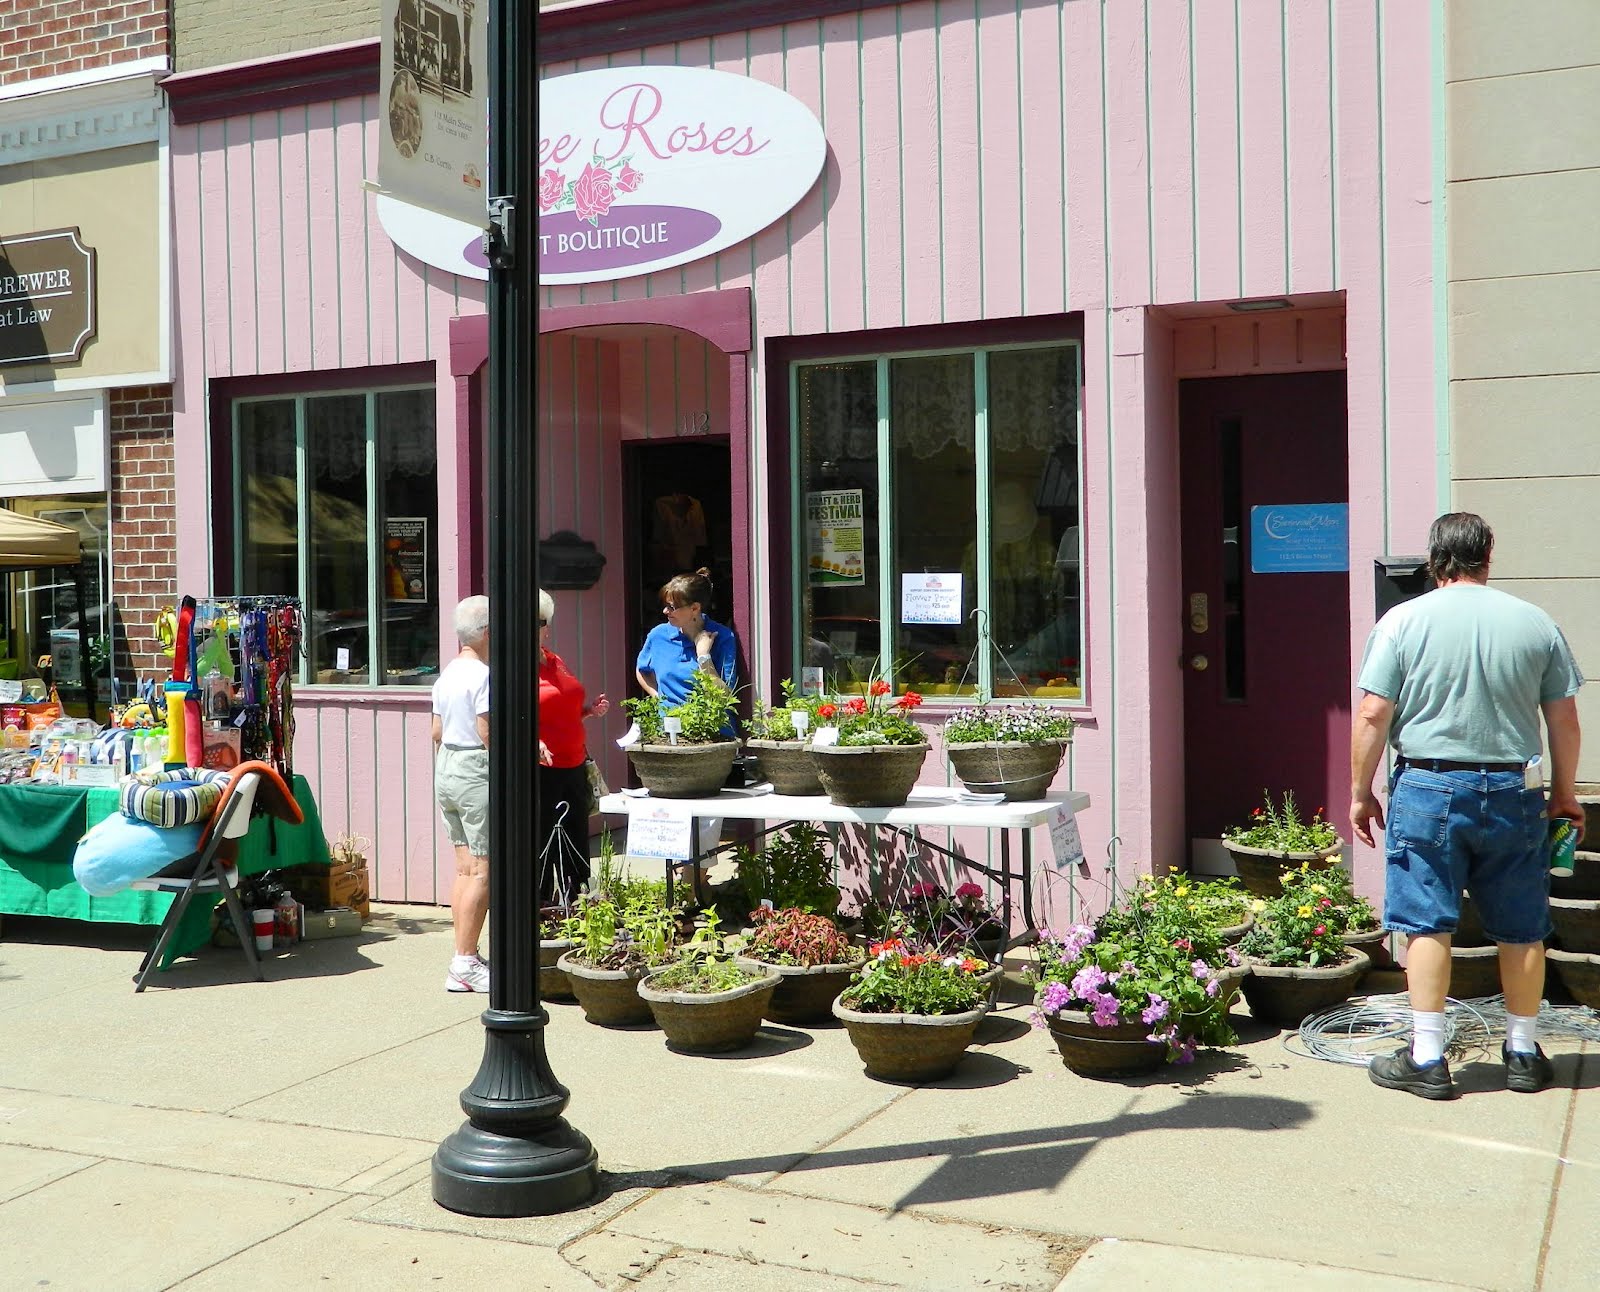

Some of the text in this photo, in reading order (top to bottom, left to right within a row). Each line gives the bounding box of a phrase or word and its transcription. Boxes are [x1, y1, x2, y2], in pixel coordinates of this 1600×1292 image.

[594, 83, 771, 160] Roses
[558, 222, 669, 254] BOUTIQUE
[17, 306, 53, 326] Law
[683, 412, 709, 434] 112
[840, 494, 861, 505] HERB
